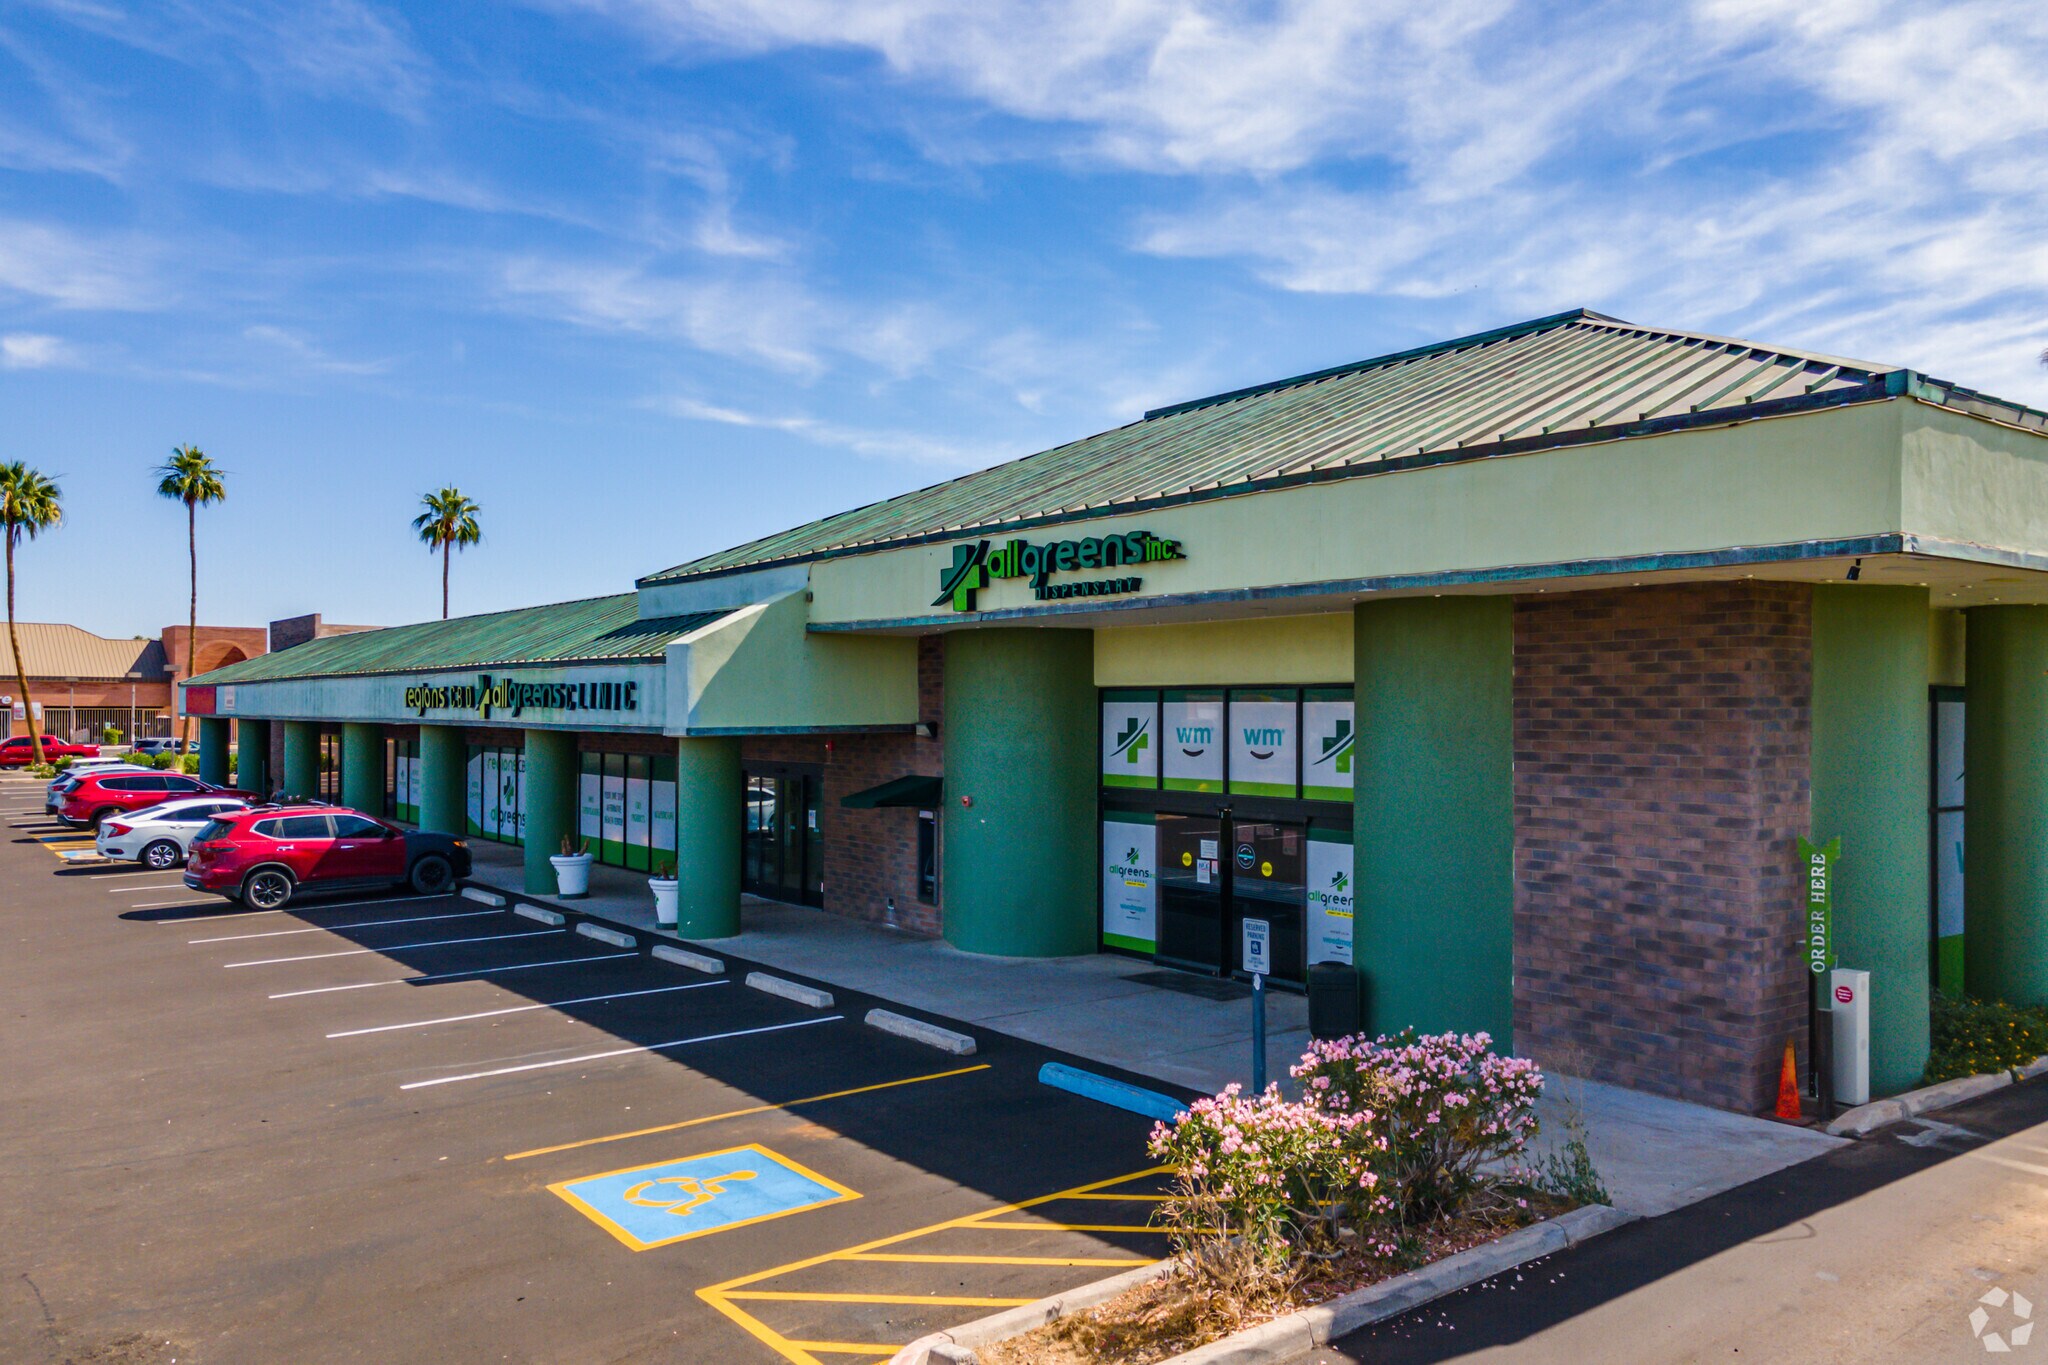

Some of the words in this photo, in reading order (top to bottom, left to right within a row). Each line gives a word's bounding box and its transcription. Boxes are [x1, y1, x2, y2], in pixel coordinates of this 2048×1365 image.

[986, 531, 1148, 589] allgreens
[1145, 536, 1180, 562] inc.
[1034, 576, 1140, 601] DISPENSARY
[405, 684, 447, 717] regions
[450, 686, 473, 709] CBD
[492, 678, 565, 717] allgreens
[565, 680, 637, 711] CLINIC
[1176, 726, 1212, 744] wm
[1243, 727, 1283, 746] wm
[1108, 864, 1150, 878] allgreens
[1810, 853, 1826, 903] HERE
[1246, 922, 1266, 932] RESERVED
[1247, 931, 1265, 941] PARKING
[1810, 911, 1826, 973] ORDER
